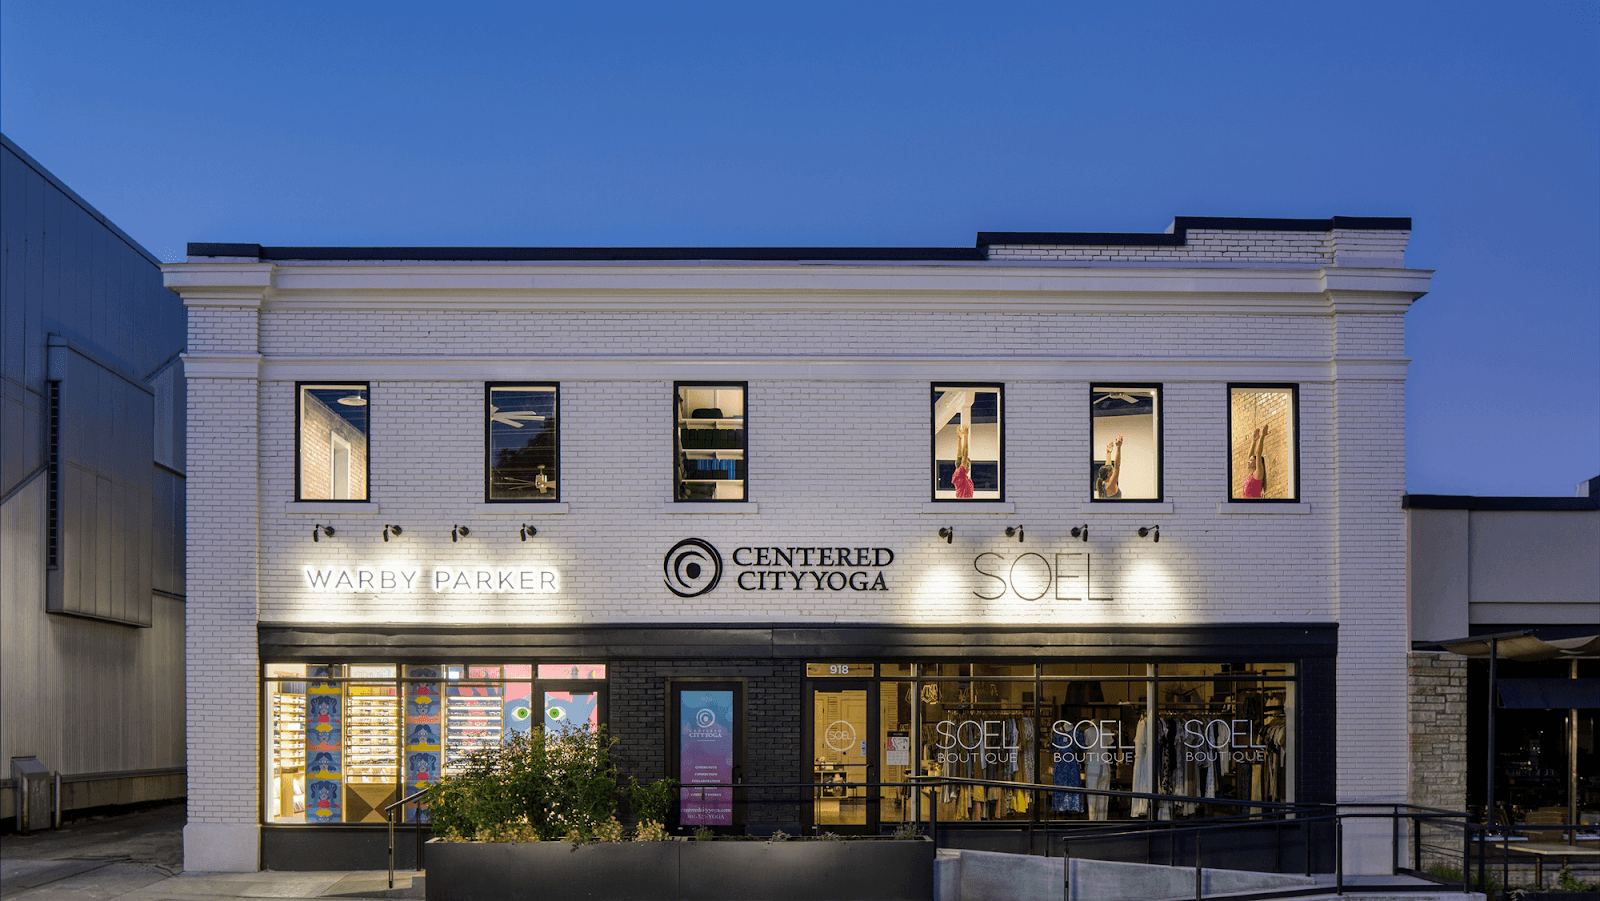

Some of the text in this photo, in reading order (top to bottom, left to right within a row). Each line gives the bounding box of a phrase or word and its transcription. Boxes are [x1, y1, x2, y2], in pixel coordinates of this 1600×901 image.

[732, 547, 895, 567] CENTERED
[307, 570, 556, 590] WARBY PARKER
[973, 552, 1114, 601] SOEL
[830, 665, 848, 674] 918
[828, 731, 852, 740] SOEL
[935, 720, 1020, 749] SOEL
[1052, 720, 1135, 749] SOEL
[1184, 719, 1267, 748] SOEL
[1053, 752, 1134, 764] BOUTIQUE
[1186, 751, 1265, 763] BOUTIQUE
